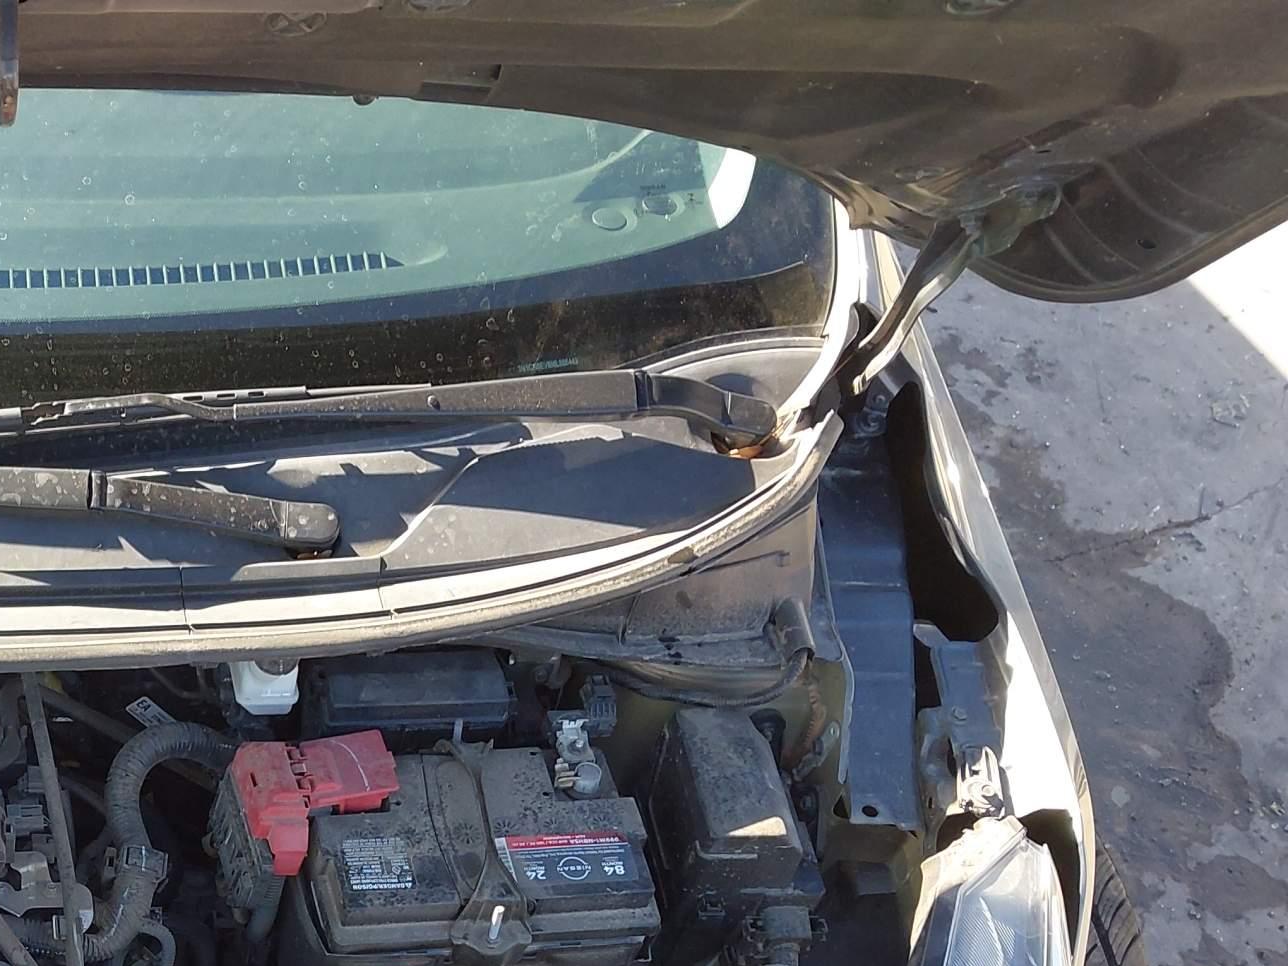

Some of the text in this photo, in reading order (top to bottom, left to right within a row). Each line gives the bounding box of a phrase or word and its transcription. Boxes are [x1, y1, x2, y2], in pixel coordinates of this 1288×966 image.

[557, 864, 592, 872] NISSAN
[602, 865, 626, 876] 84
[525, 870, 547, 880] 24
